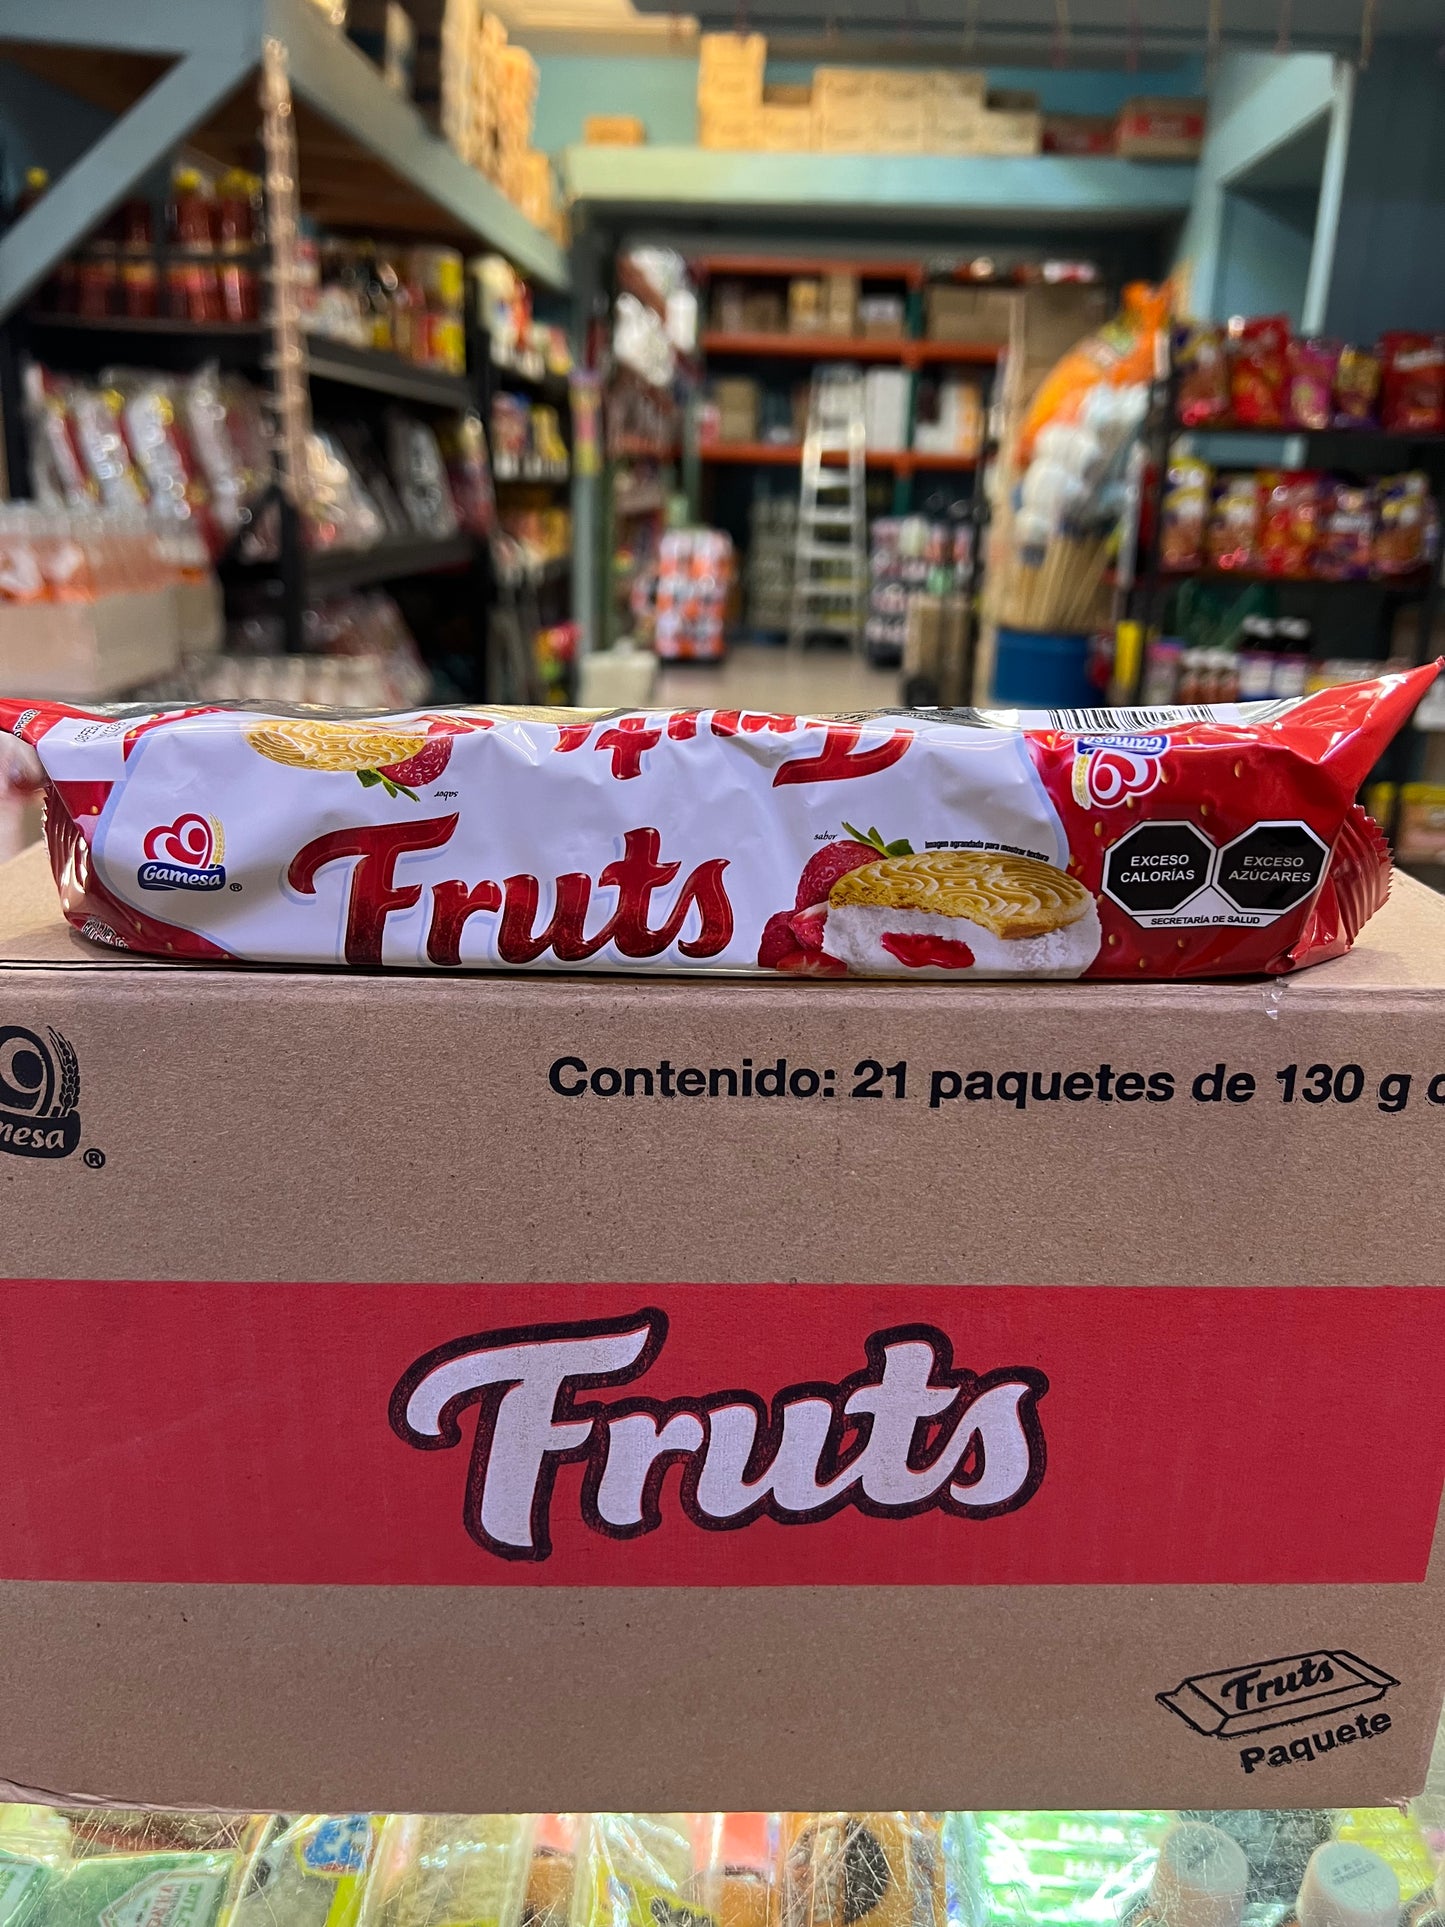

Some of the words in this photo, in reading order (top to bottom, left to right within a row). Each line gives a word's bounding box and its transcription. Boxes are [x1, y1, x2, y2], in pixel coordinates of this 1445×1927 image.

[434, 791, 458, 801] sabor
[813, 831, 838, 841] sabor
[1130, 854, 1190, 868] EXCESO
[1243, 855, 1304, 869] EXCESO
[143, 865, 222, 885] Gamesa
[1120, 868, 1195, 884] CALORÍAS
[1228, 870, 1311, 884] AZÚCARES
[287, 812, 734, 966] Fruts
[1151, 915, 1209, 926] SECRETARÍA
[1212, 915, 1225, 924] DE
[1228, 915, 1260, 925] SALUD
[549, 1056, 836, 1098] Contenido:
[852, 1060, 908, 1099] 21
[930, 1063, 1175, 1108] paquetes
[1191, 1064, 1256, 1103] de
[1276, 1064, 1364, 1104] 130
[1378, 1075, 1411, 1112] g
[389, 1307, 1049, 1561] Fruts
[1221, 1658, 1334, 1710] Fruts
[1240, 1711, 1392, 1773] Paquete
